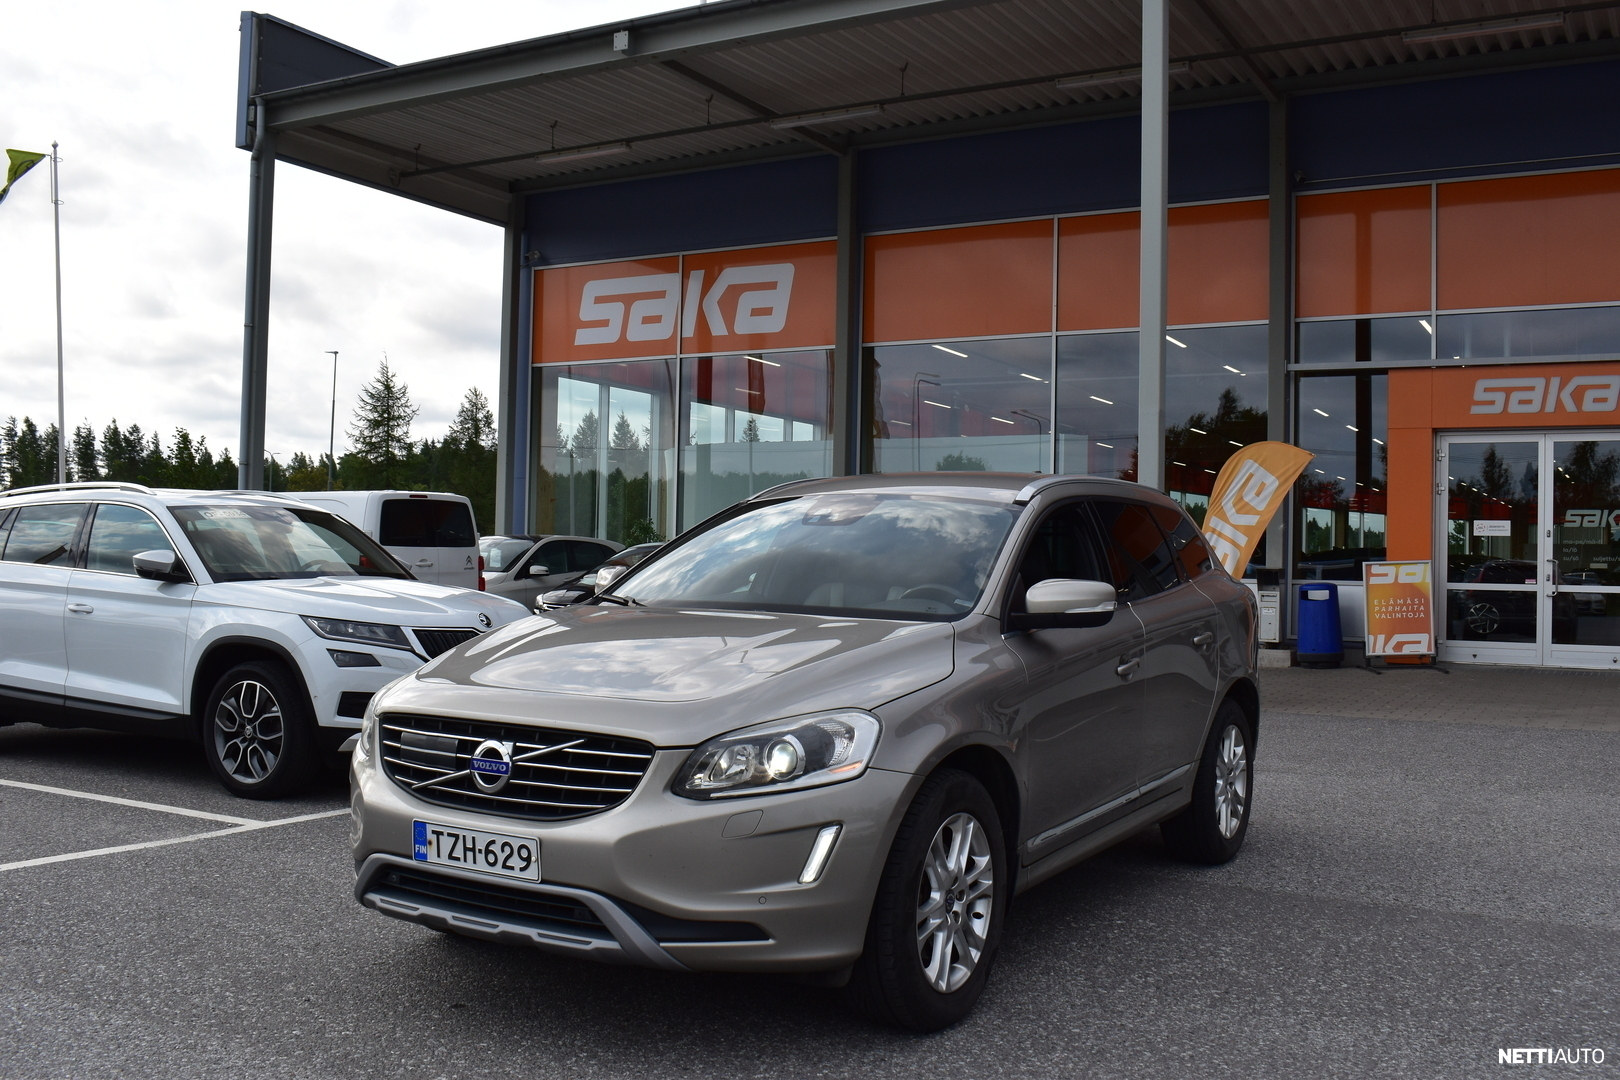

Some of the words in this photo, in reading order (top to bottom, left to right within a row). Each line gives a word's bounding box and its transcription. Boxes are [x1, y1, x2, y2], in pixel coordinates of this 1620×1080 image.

[472, 760, 507, 772] VOLVO
[415, 845, 427, 854] FIN
[431, 829, 532, 872] TZH-629
